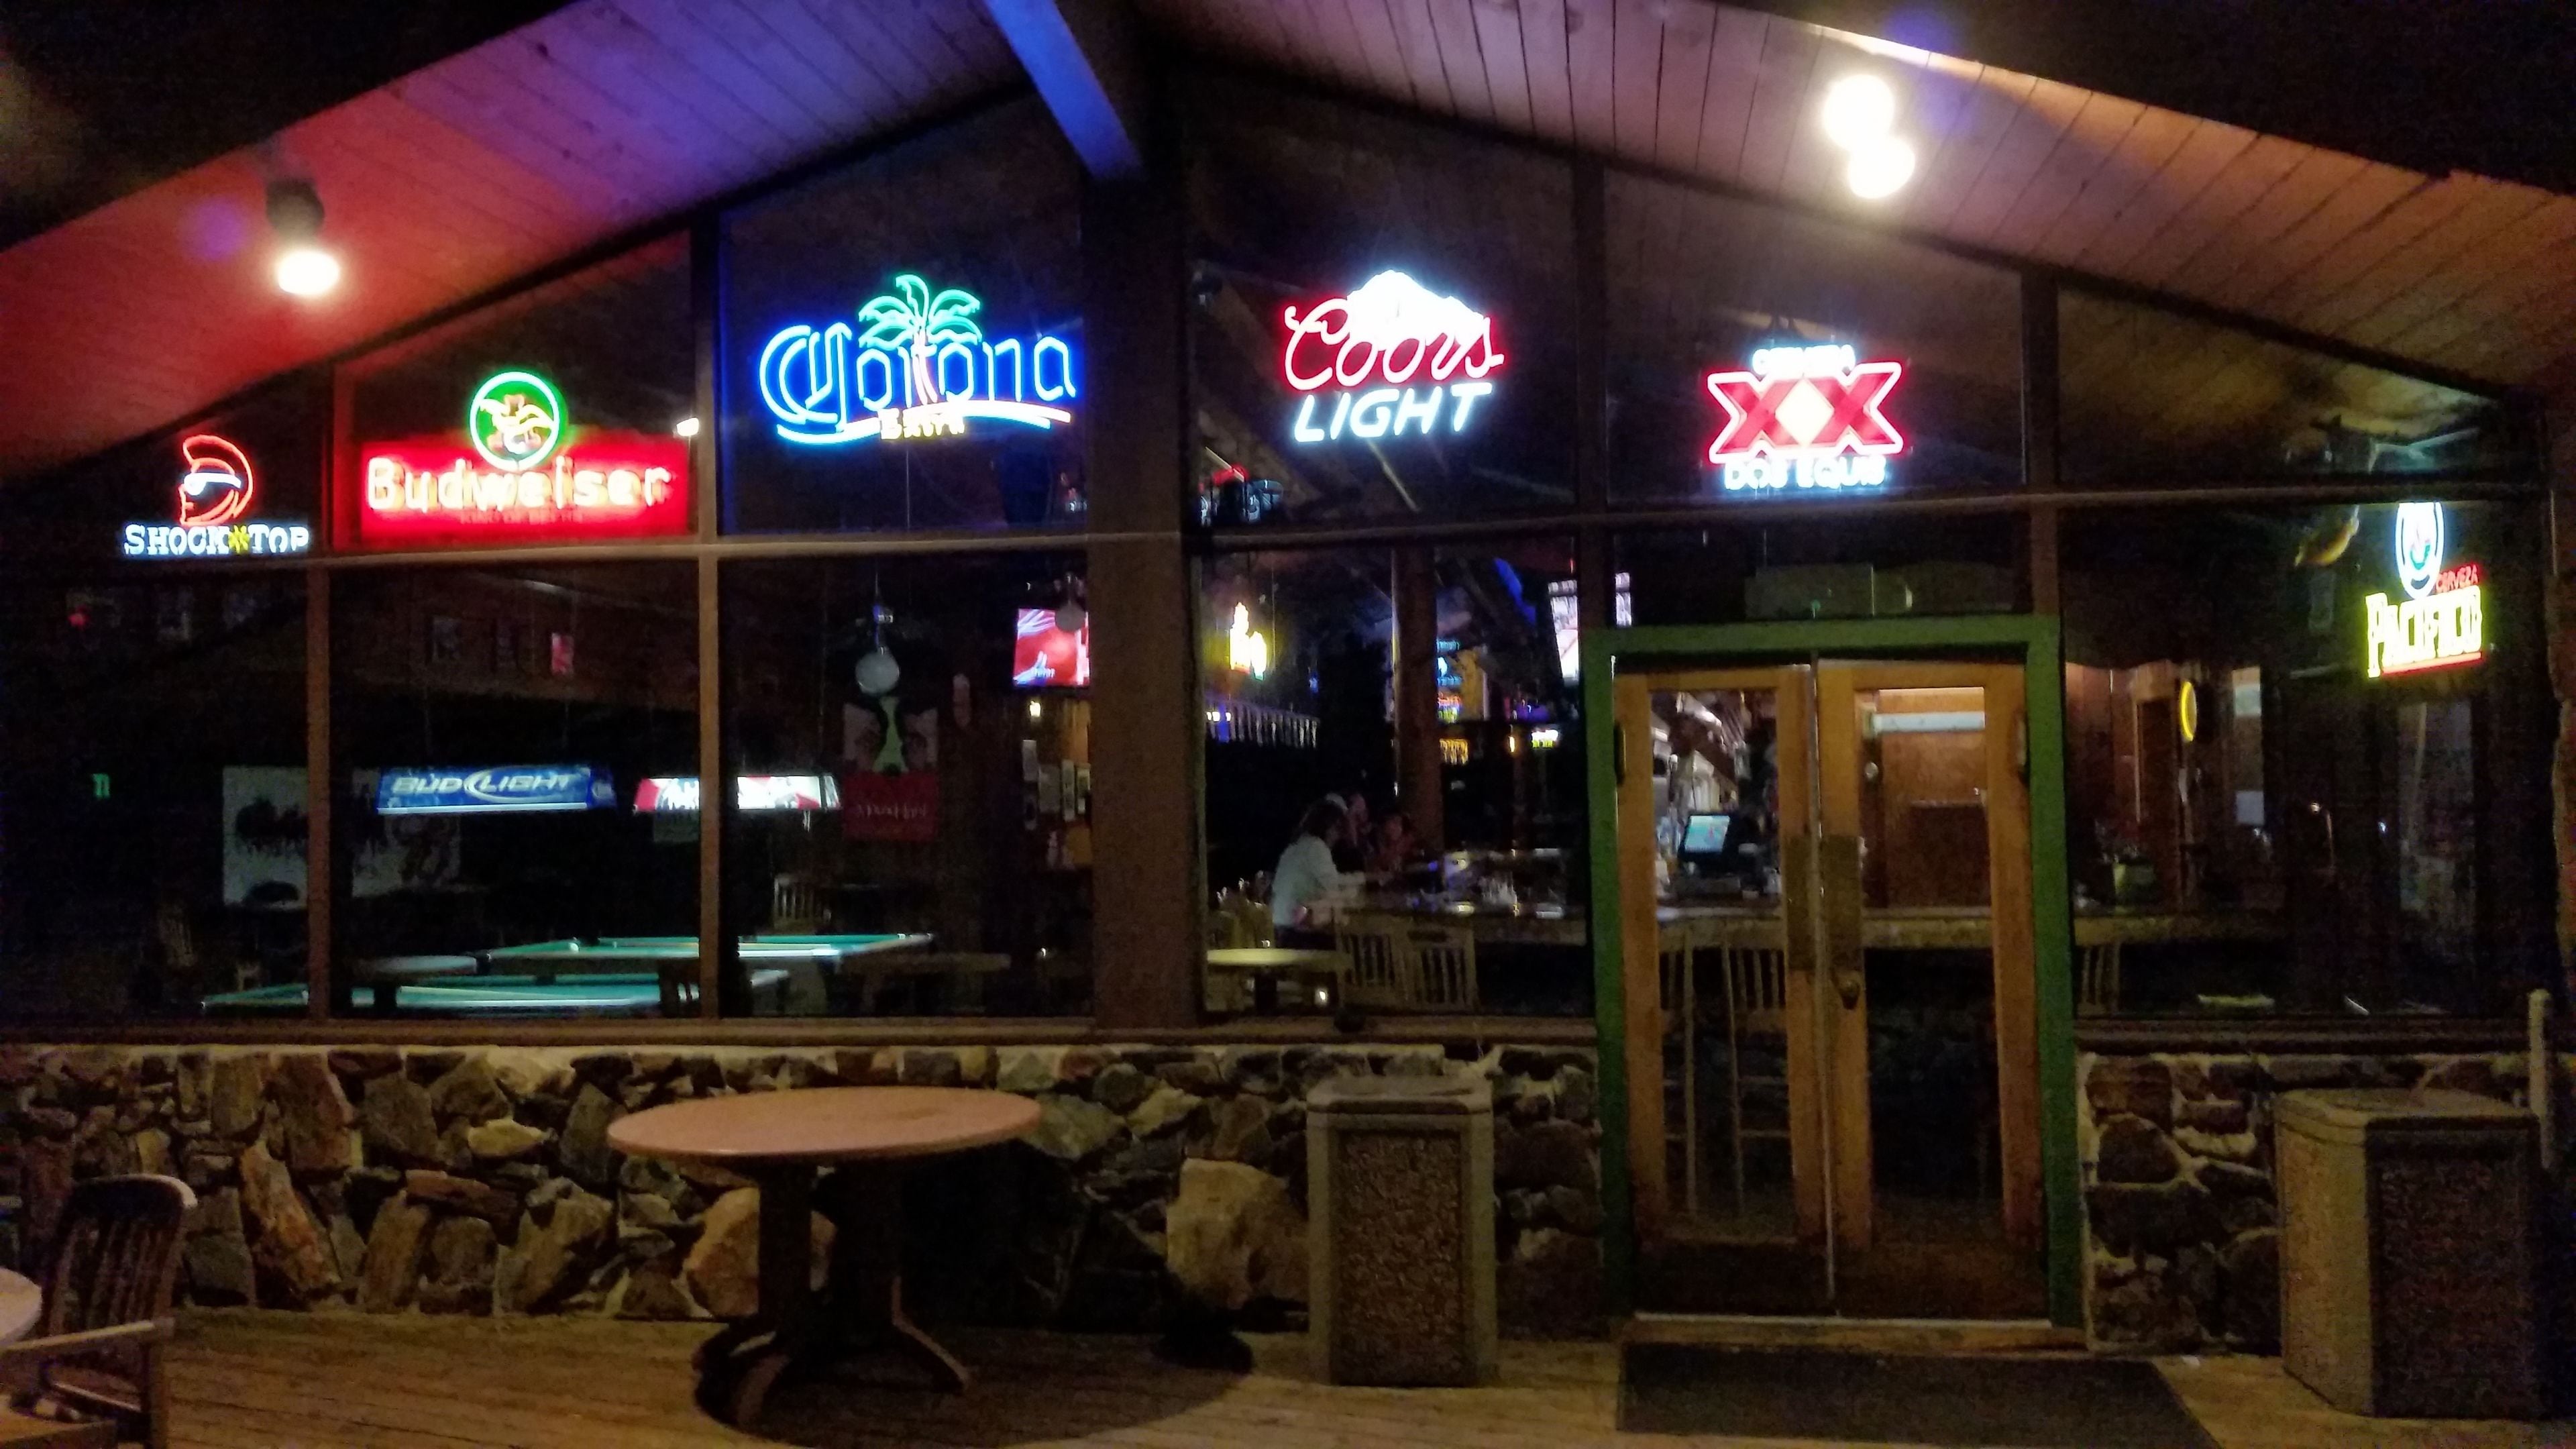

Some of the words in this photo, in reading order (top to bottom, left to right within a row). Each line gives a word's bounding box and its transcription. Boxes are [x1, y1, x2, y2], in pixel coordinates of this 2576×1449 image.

[1284, 298, 1505, 390] Coors
[759, 323, 1076, 433] Corona
[1294, 382, 1493, 442] LIGHT
[1710, 366, 1900, 460] XX
[367, 456, 672, 513] Budweiser
[123, 523, 230, 555] SHOCK
[248, 523, 309, 555] TOP
[392, 776, 463, 794] BUD
[478, 774, 571, 792] LIGHT
